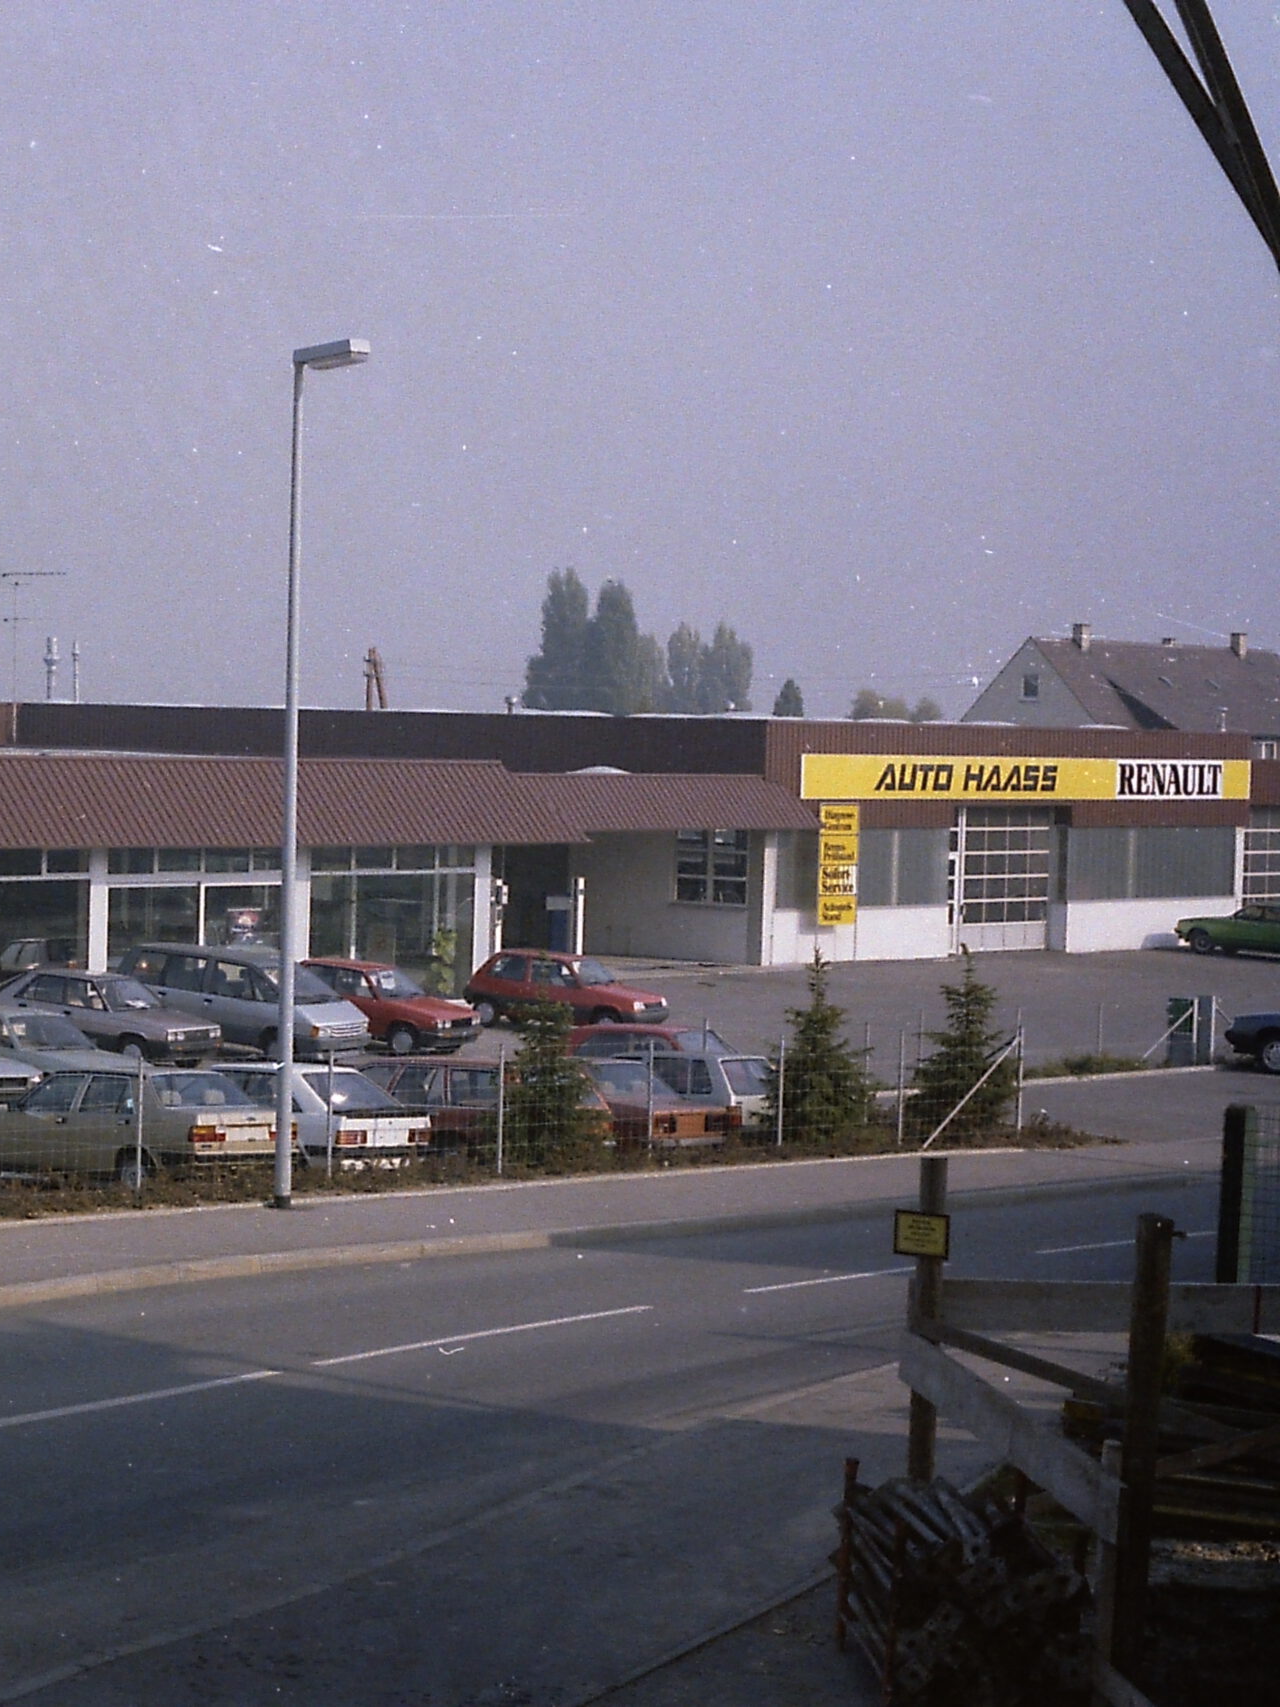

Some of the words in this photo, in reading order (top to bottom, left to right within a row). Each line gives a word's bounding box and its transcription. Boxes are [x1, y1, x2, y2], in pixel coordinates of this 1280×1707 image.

[874, 763, 954, 792] AUTO
[963, 764, 1059, 792] HAASS
[1117, 763, 1222, 796] RENAULT
[821, 880, 854, 893] Service
